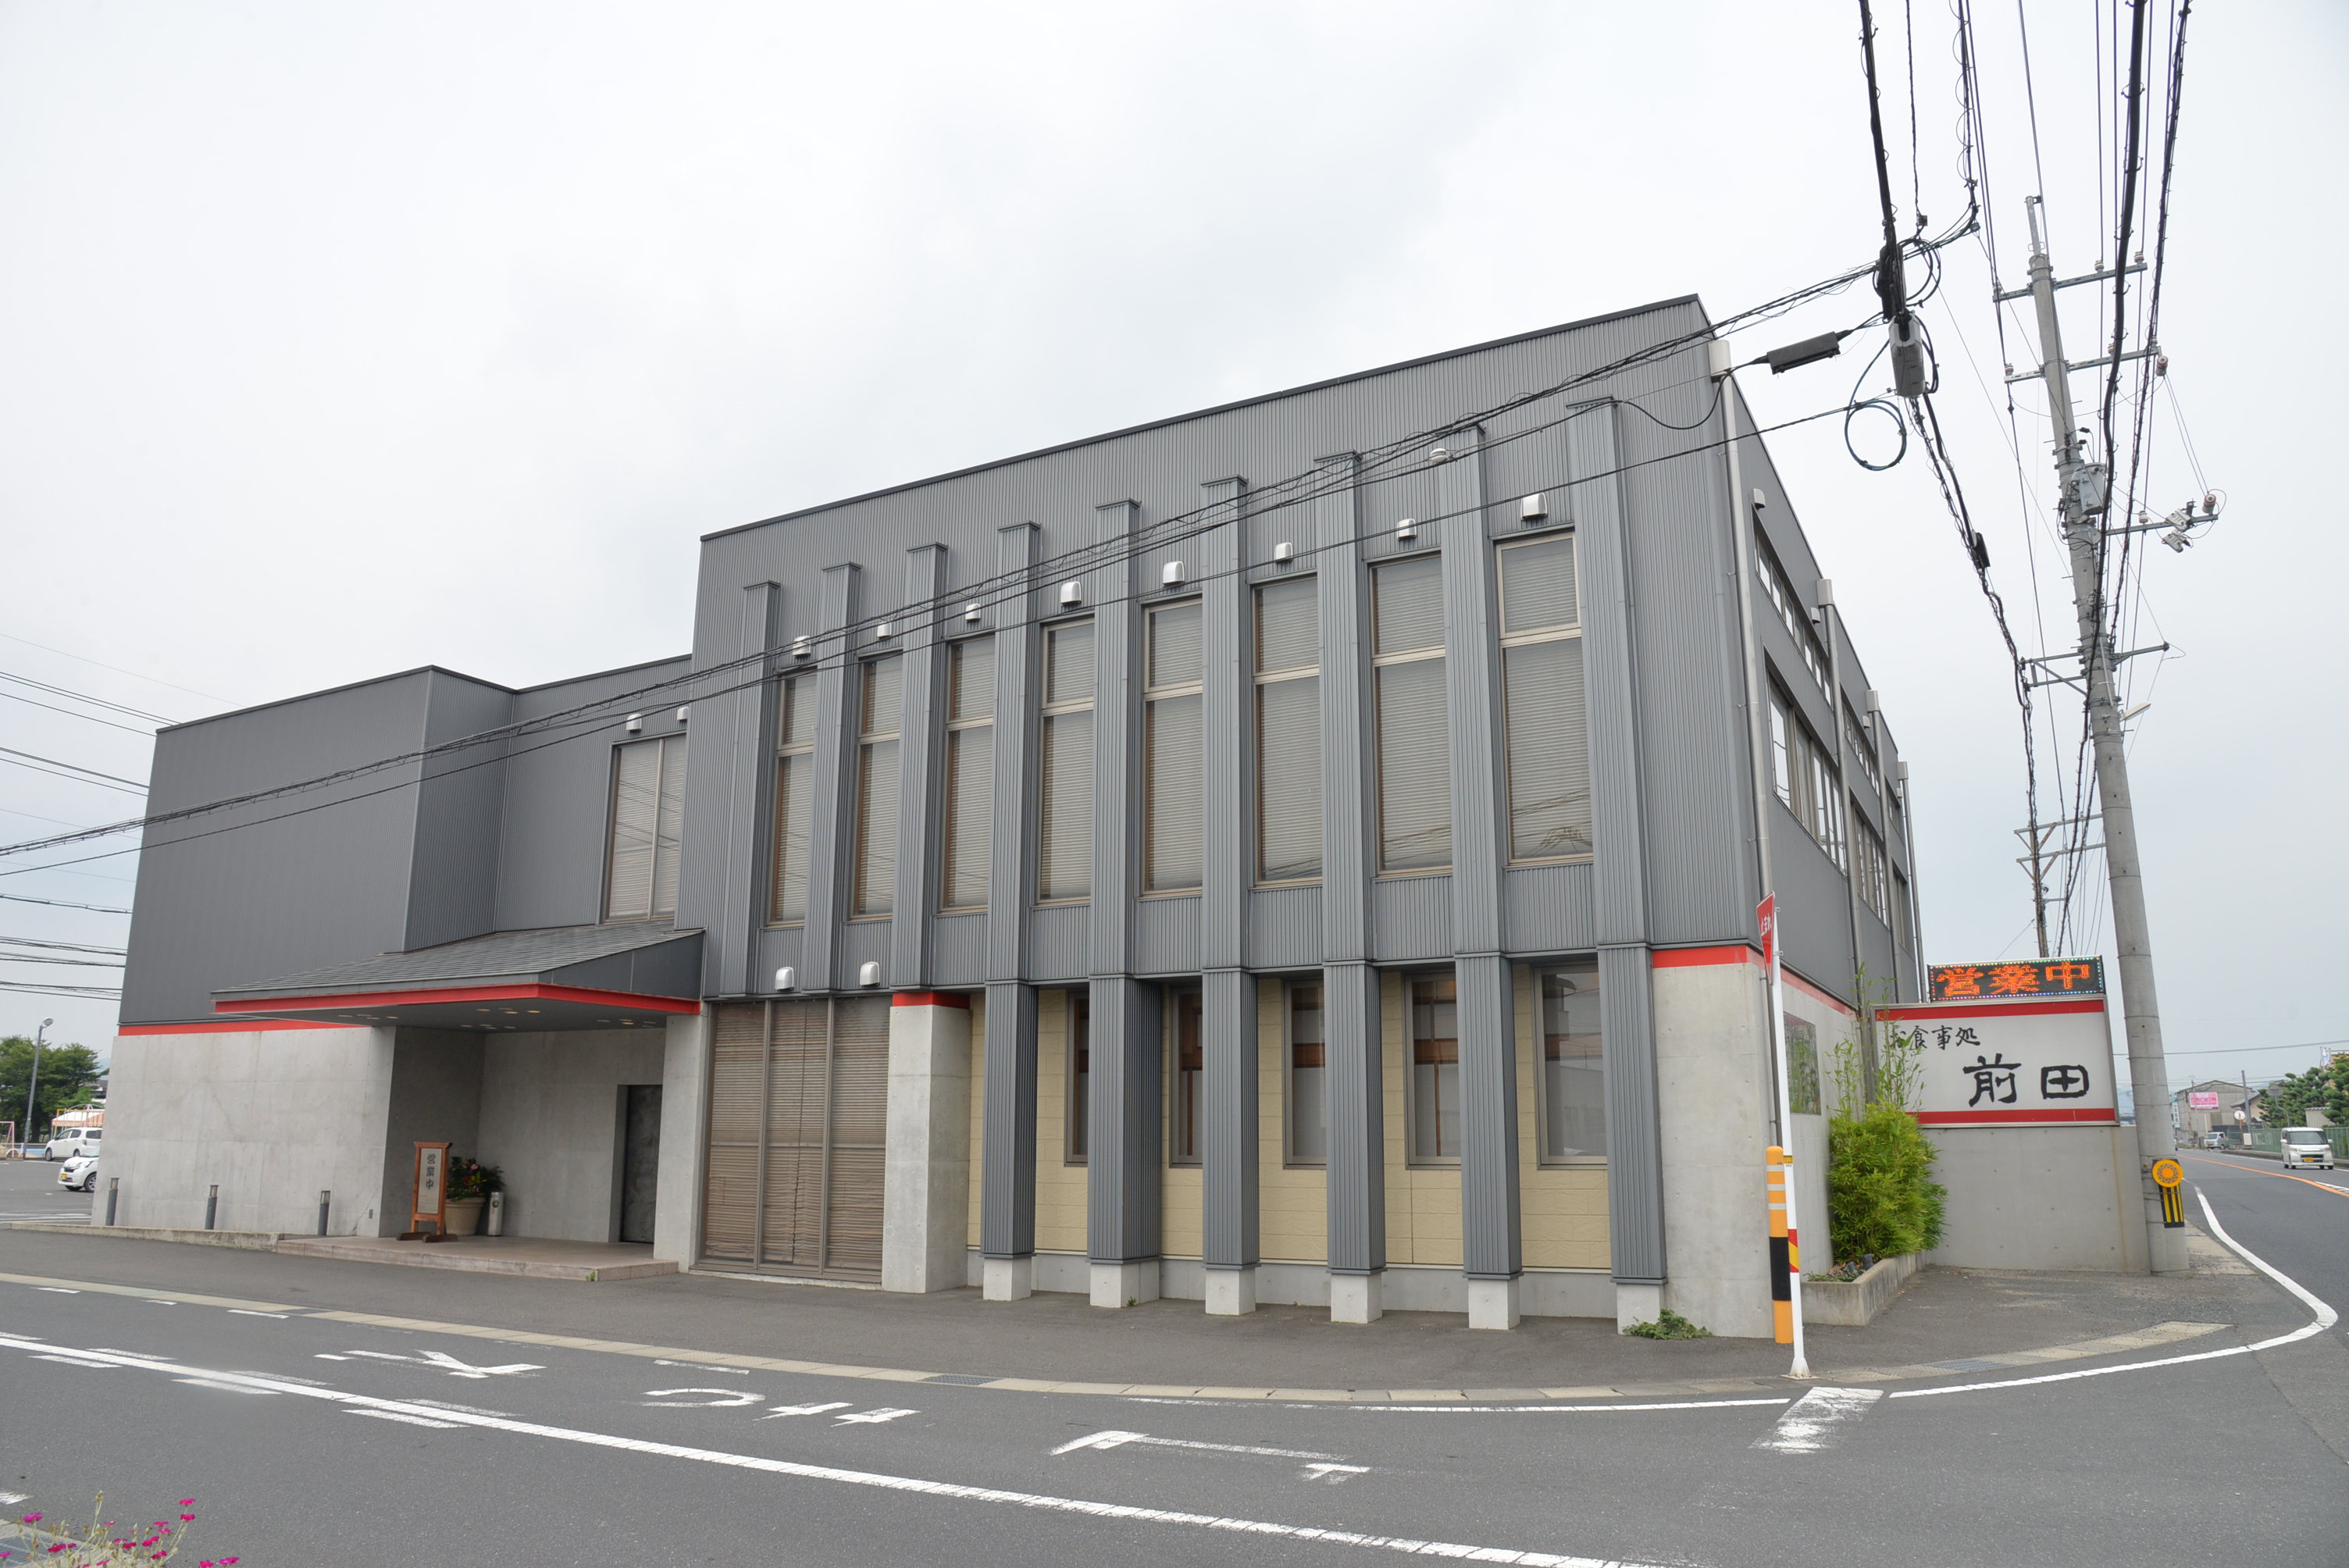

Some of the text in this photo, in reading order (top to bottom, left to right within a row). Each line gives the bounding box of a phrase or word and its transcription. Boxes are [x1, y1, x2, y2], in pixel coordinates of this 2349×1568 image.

[1761, 913, 1772, 937] 止まれ
[1936, 960, 2091, 997] 営業中
[1890, 1025, 1980, 1050] お食事処
[1962, 1053, 2090, 1107] 前田
[426, 1153, 436, 1189] 営業中
